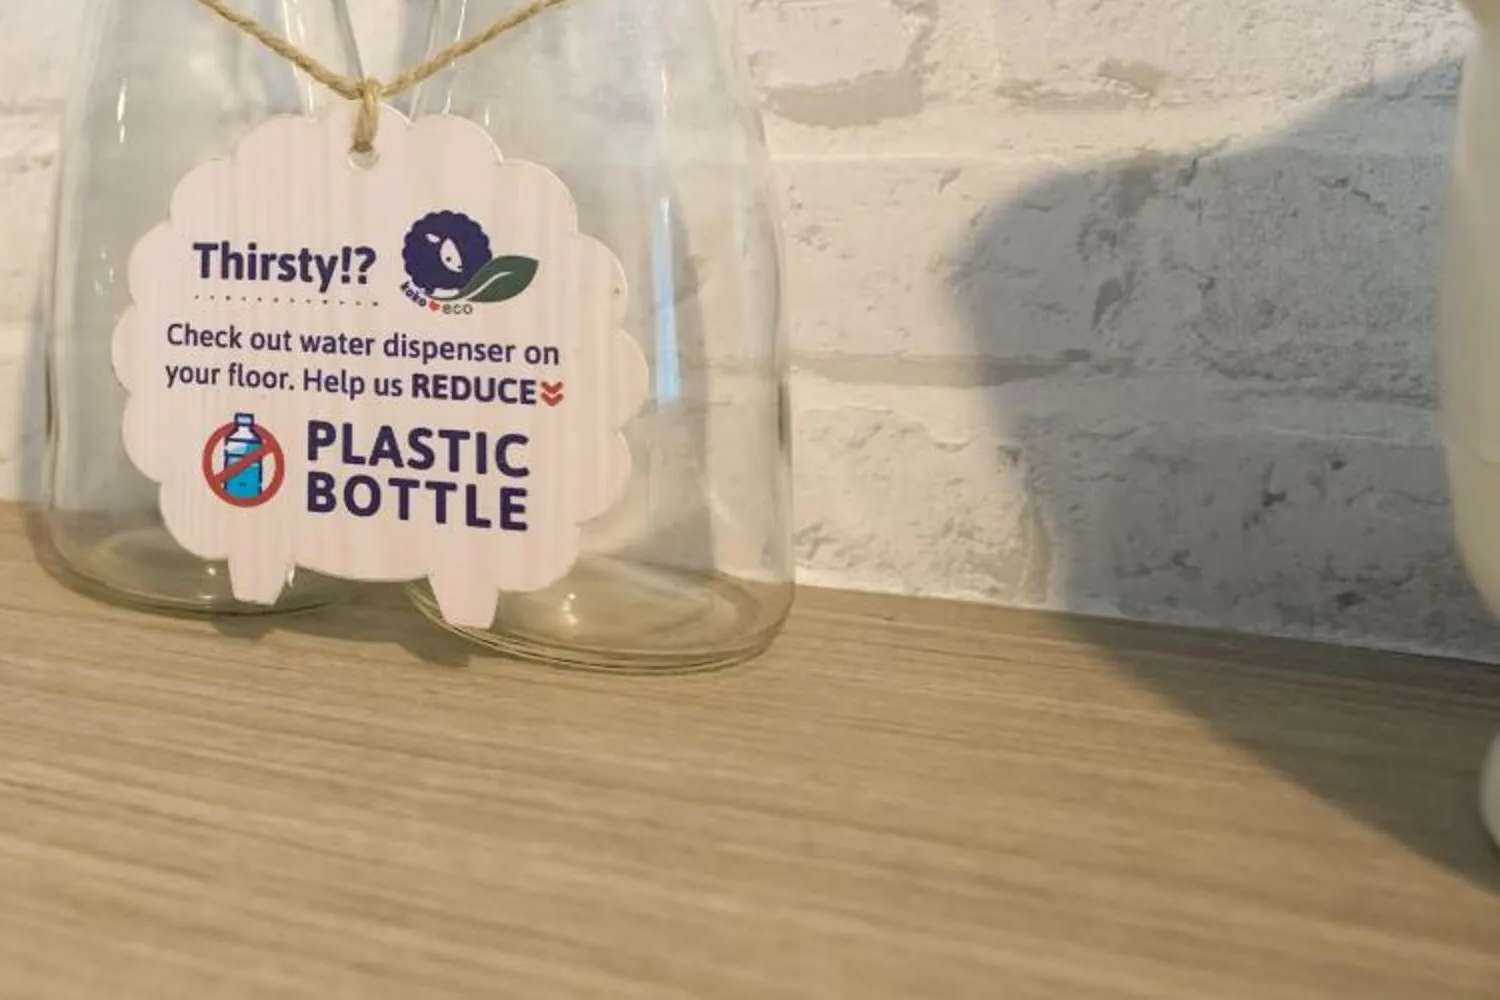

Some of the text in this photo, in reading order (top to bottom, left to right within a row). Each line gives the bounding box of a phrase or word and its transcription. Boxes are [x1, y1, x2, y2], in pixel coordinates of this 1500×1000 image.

[192, 240, 377, 293] Thirsty!?
[442, 303, 473, 315] eco
[166, 322, 559, 366] Check out water dispenser on
[165, 362, 537, 405] your floor. Help us REDUCE
[307, 420, 530, 478] PLASTIC
[306, 472, 528, 531] BOTTLE
